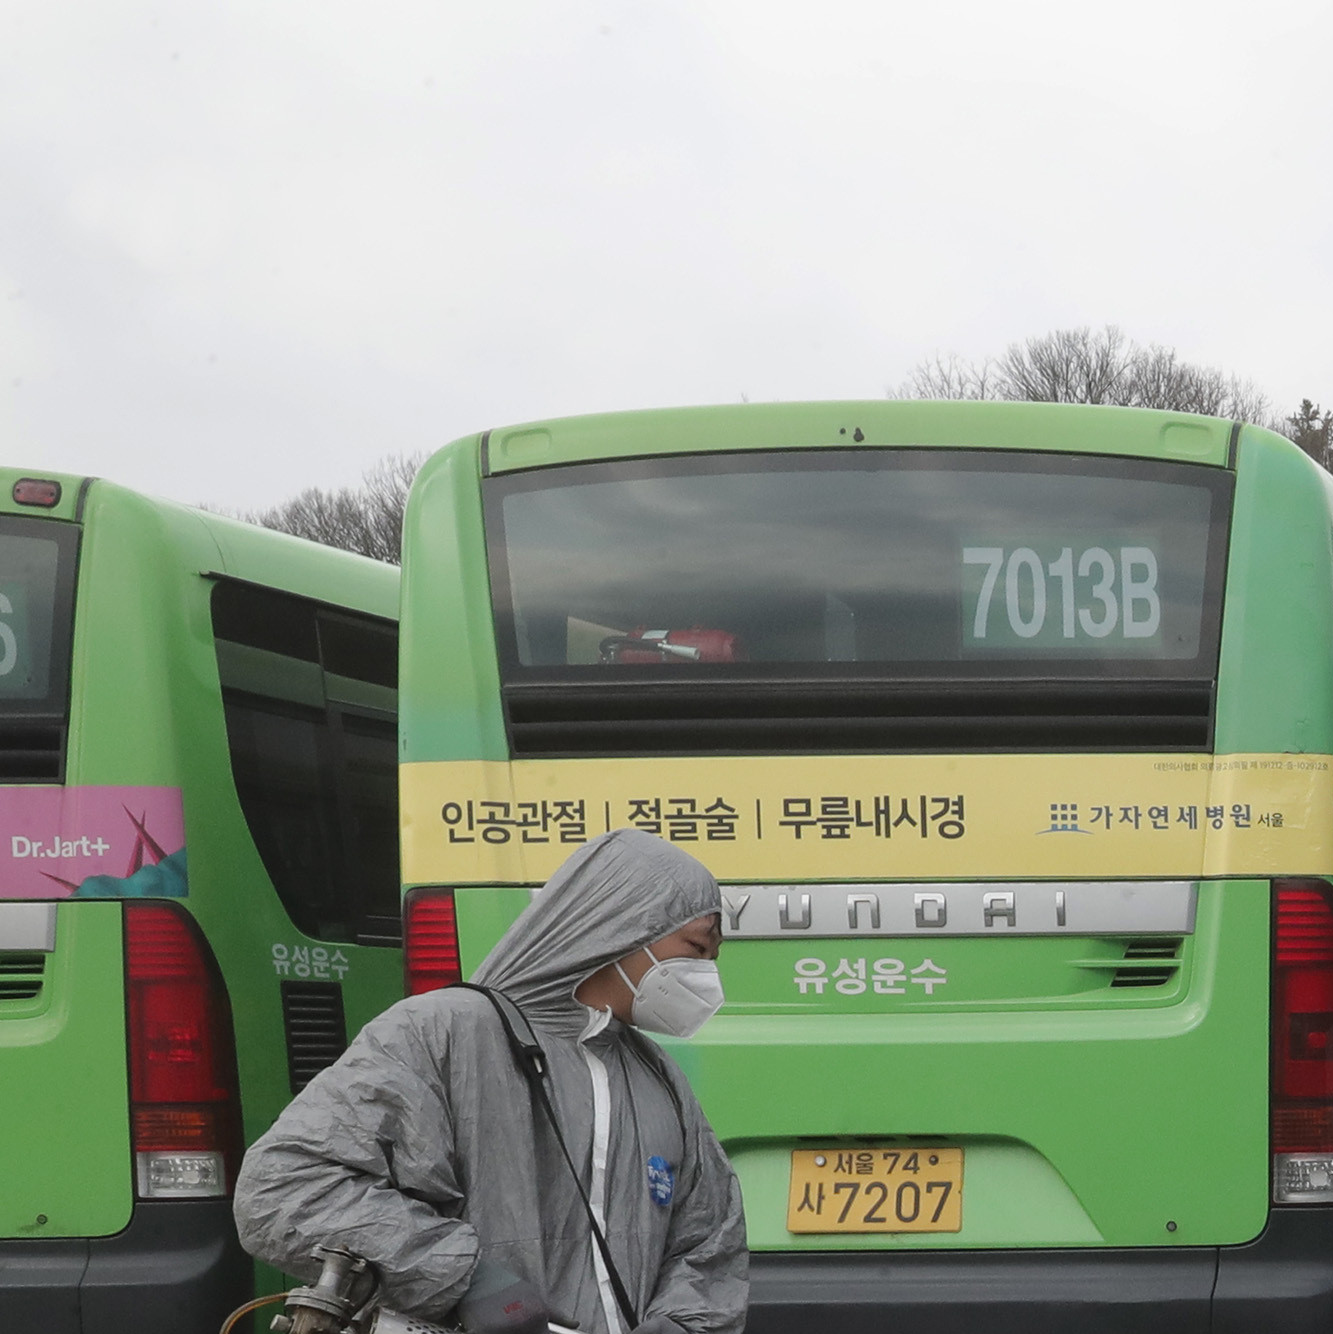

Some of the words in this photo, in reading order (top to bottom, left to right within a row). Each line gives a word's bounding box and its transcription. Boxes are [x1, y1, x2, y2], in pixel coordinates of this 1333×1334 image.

[962, 546, 1161, 638] 7013B
[441, 800, 588, 845] 인공관절
[627, 797, 739, 841] 절골술
[778, 795, 966, 840] 무릎내시경
[1089, 803, 1251, 830] 가자연세병원
[1257, 812, 1285, 828] 서울
[11, 836, 110, 858] Dr.Jart+
[722, 891, 1066, 930] YUNDAI
[271, 943, 350, 981] 유성운수
[793, 957, 948, 995] 유성운수
[834, 1152, 874, 1175] 서울
[882, 1152, 921, 1175] 74
